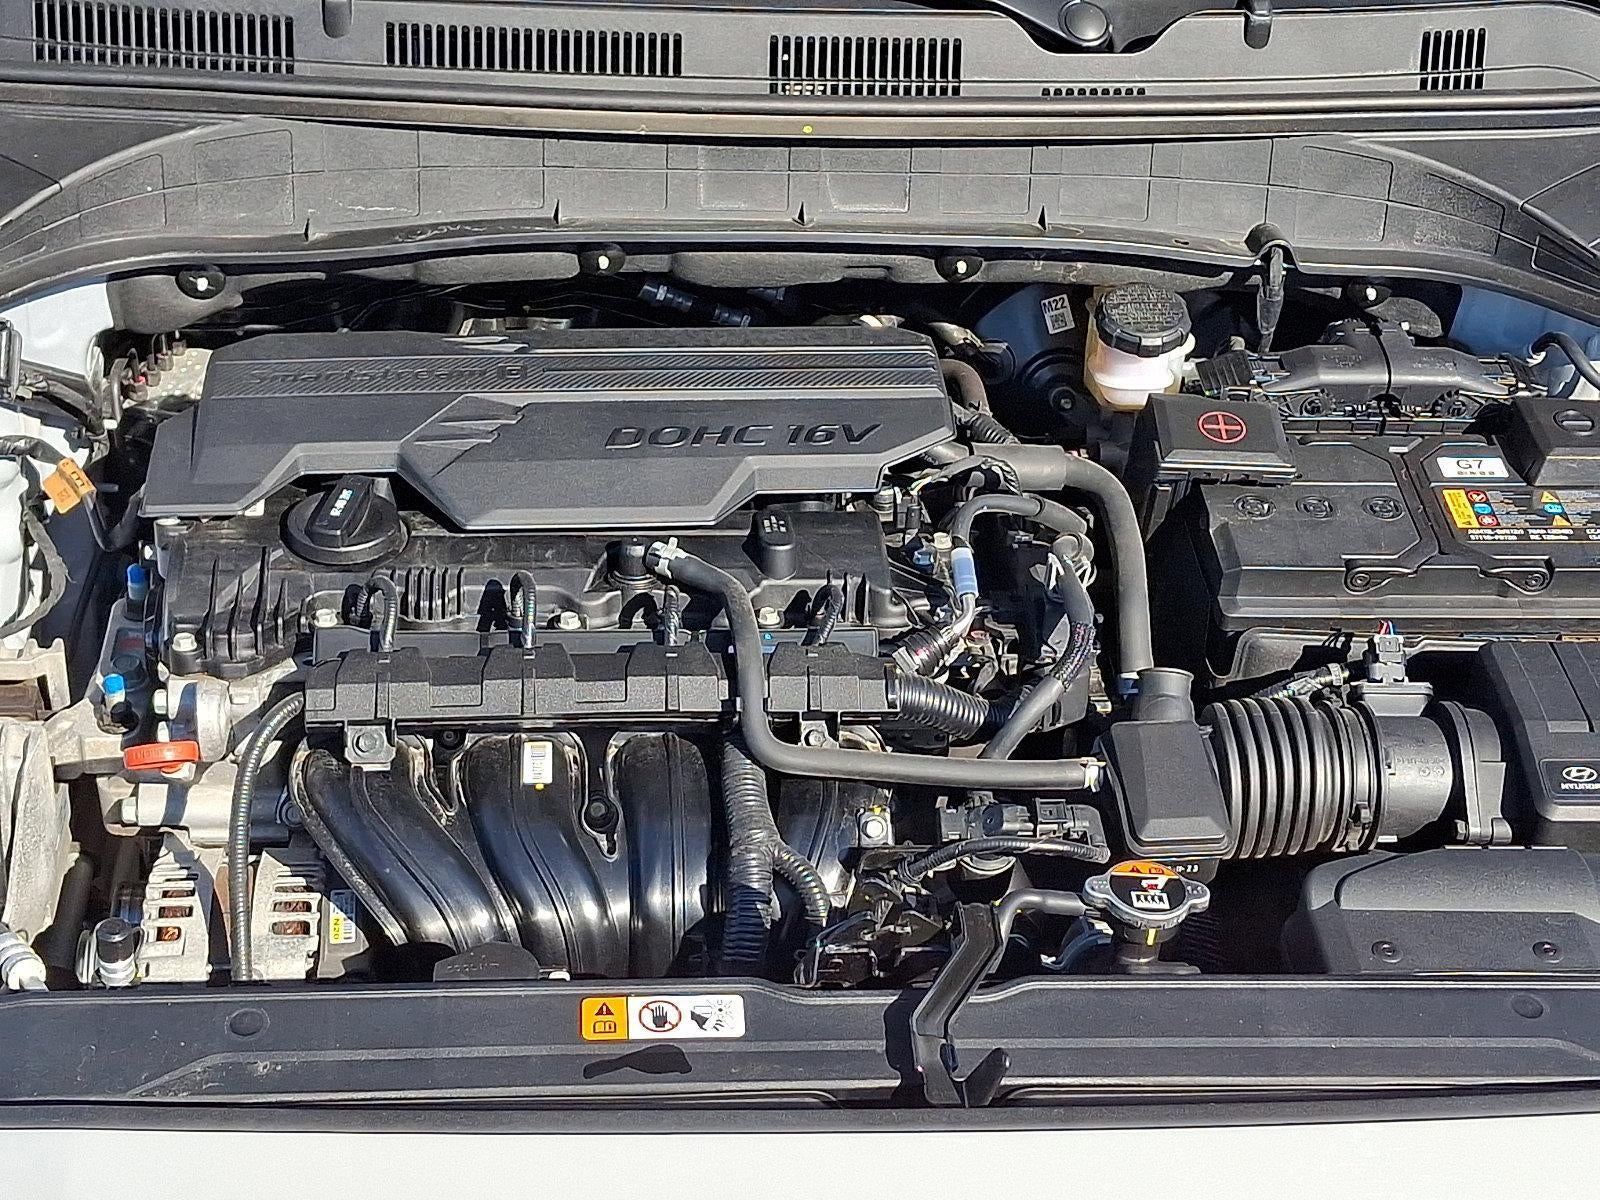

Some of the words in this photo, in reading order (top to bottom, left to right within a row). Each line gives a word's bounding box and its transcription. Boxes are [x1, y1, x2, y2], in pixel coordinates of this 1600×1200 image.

[1042, 297, 1066, 314] M22
[604, 424, 773, 449] DOHC
[787, 423, 882, 446] 16V
[1456, 459, 1483, 470] G7
